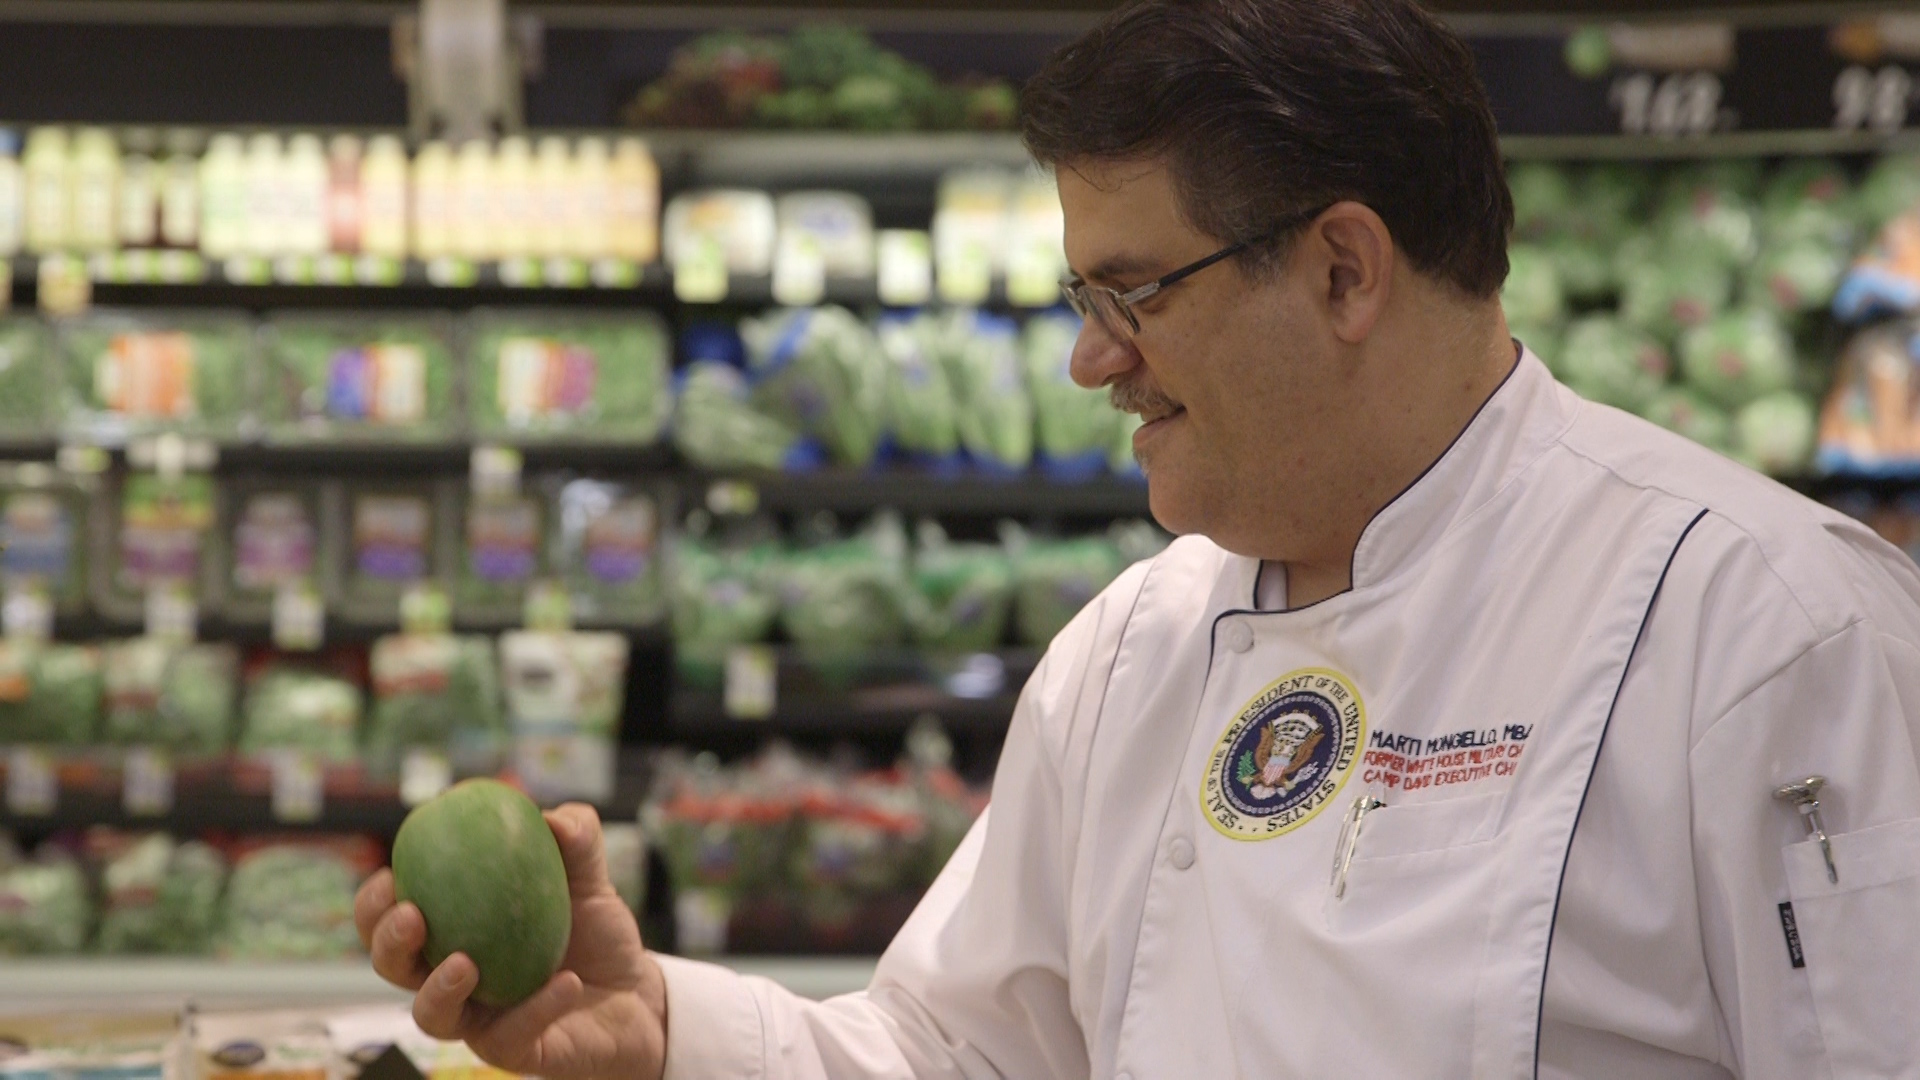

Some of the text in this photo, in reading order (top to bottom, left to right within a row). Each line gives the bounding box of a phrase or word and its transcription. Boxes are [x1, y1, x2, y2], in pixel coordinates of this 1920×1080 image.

[1315, 676, 1330, 689] OF
[1329, 681, 1349, 704] THE
[1222, 674, 1314, 744] PRESIDENT
[1335, 701, 1360, 771] UNITED
[1369, 729, 1422, 756] MARTI
[1363, 769, 1400, 788] CAMP
[1266, 778, 1337, 833] STATES
